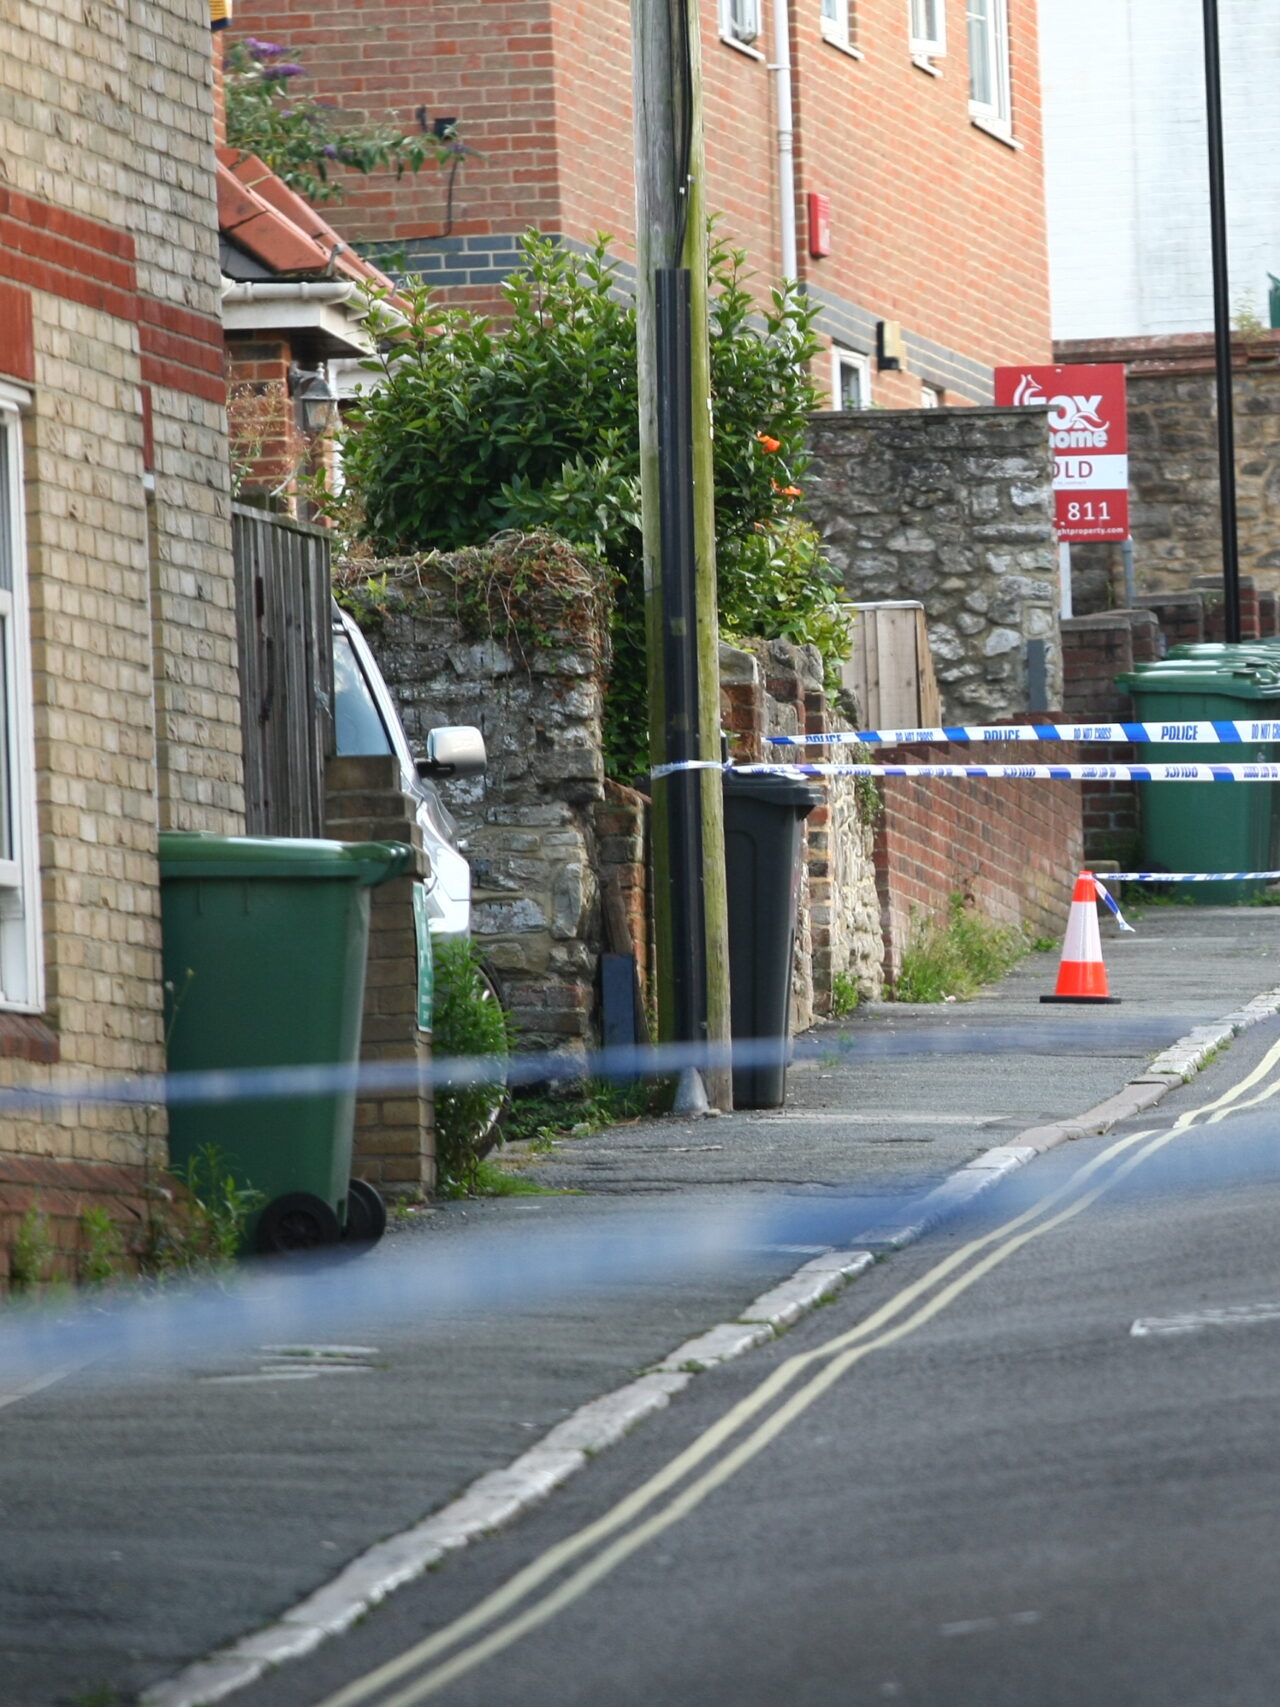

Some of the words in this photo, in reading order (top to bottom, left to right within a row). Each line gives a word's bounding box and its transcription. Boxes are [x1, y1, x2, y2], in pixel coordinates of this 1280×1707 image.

[1067, 501, 1111, 520] 811
[983, 729, 1020, 740] POLICE
[1161, 725, 1199, 740] POLICE
